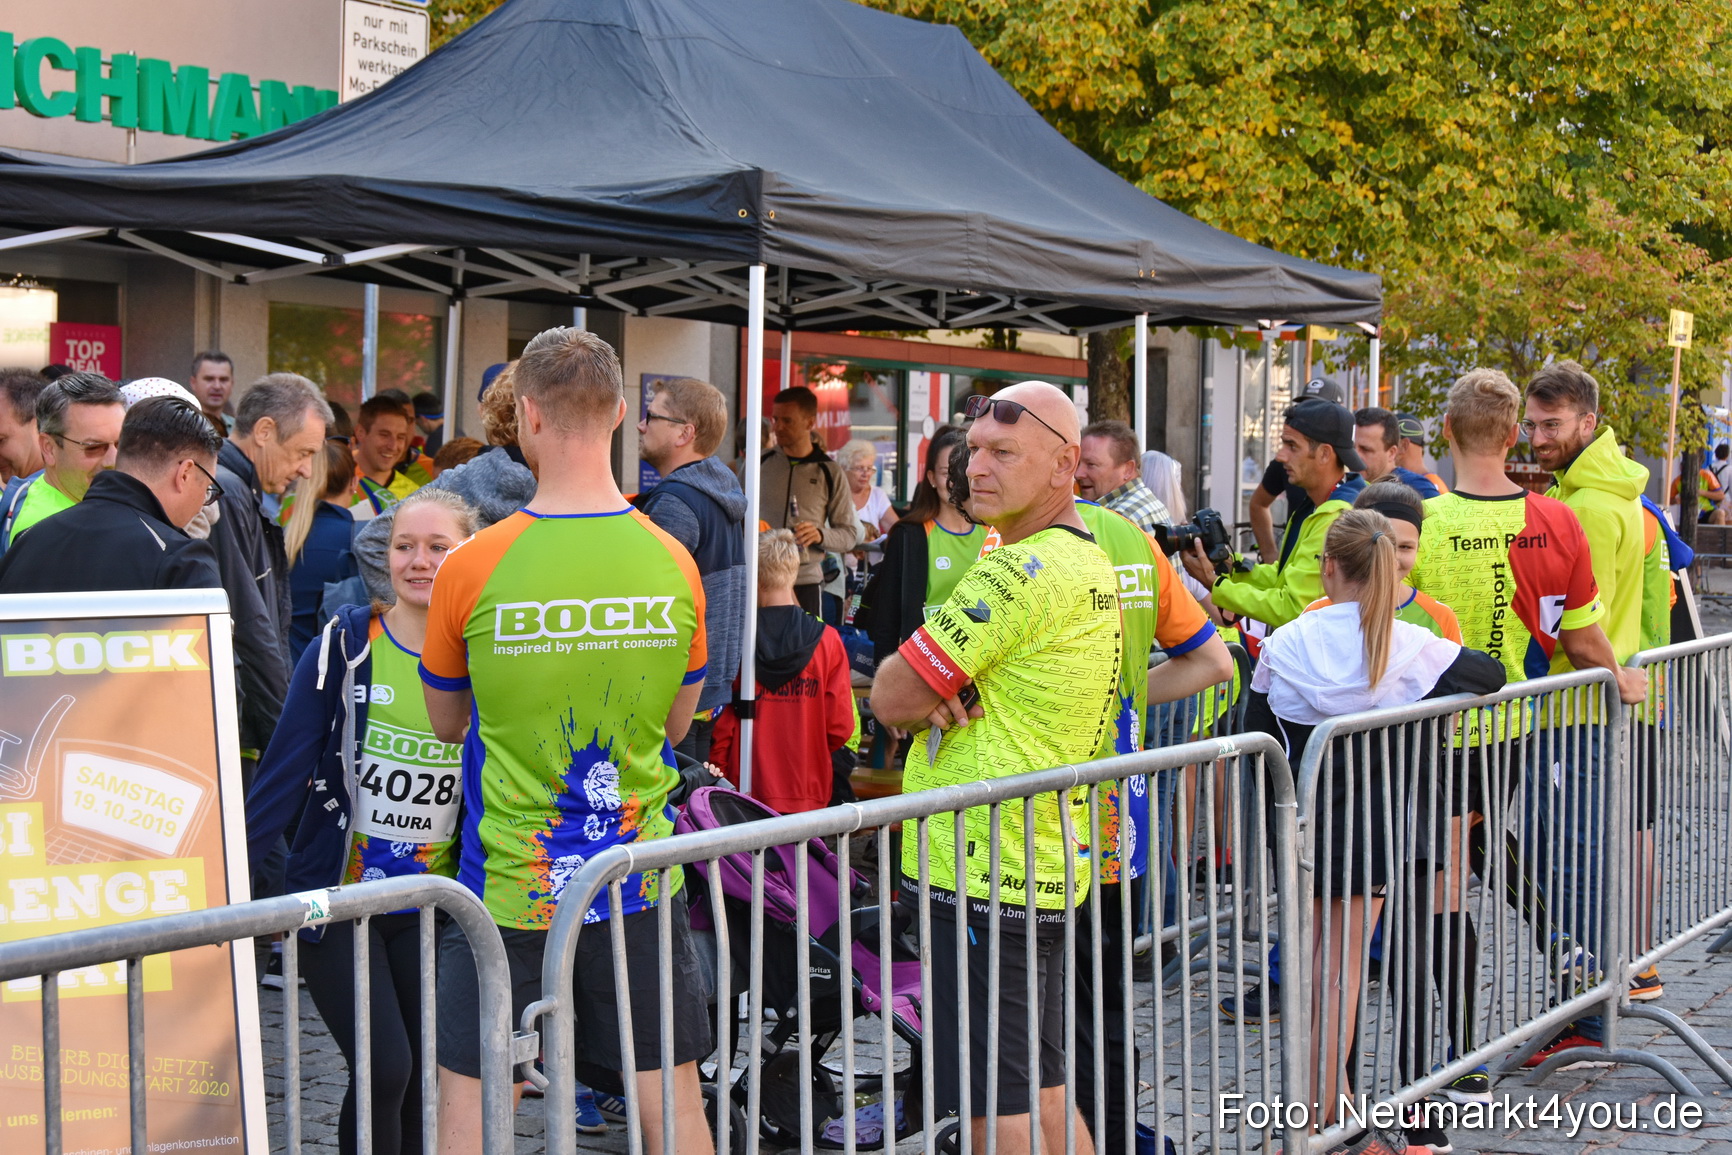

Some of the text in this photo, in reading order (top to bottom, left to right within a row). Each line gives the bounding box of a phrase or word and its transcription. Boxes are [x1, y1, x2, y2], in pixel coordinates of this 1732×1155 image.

[364, 15, 408, 35] nur mit
[353, 32, 417, 59] Parkschein
[65, 339, 105, 359] TOP
[65, 359, 105, 376] DEAL
[1449, 533, 1547, 552] Team Partl
[1089, 587, 1117, 611] Team
[496, 598, 675, 639] BOCK
[1486, 562, 1508, 659] otorsport
[4, 631, 205, 674] BOCK
[493, 637, 677, 657] inspired by smart concepts
[364, 726, 461, 763] BOCK
[76, 766, 185, 816] SAMSTAG
[361, 763, 456, 806] 4028
[73, 789, 177, 838] 19.10.2019
[371, 809, 432, 830] LAURA
[809, 966, 831, 974] Britax
[11, 1045, 215, 1077] BERB DIC JETZT:
[188, 1079, 230, 1097] 2020
[7, 1113, 39, 1128] uns
[147, 1135, 240, 1153] nlagenkonstruktion
